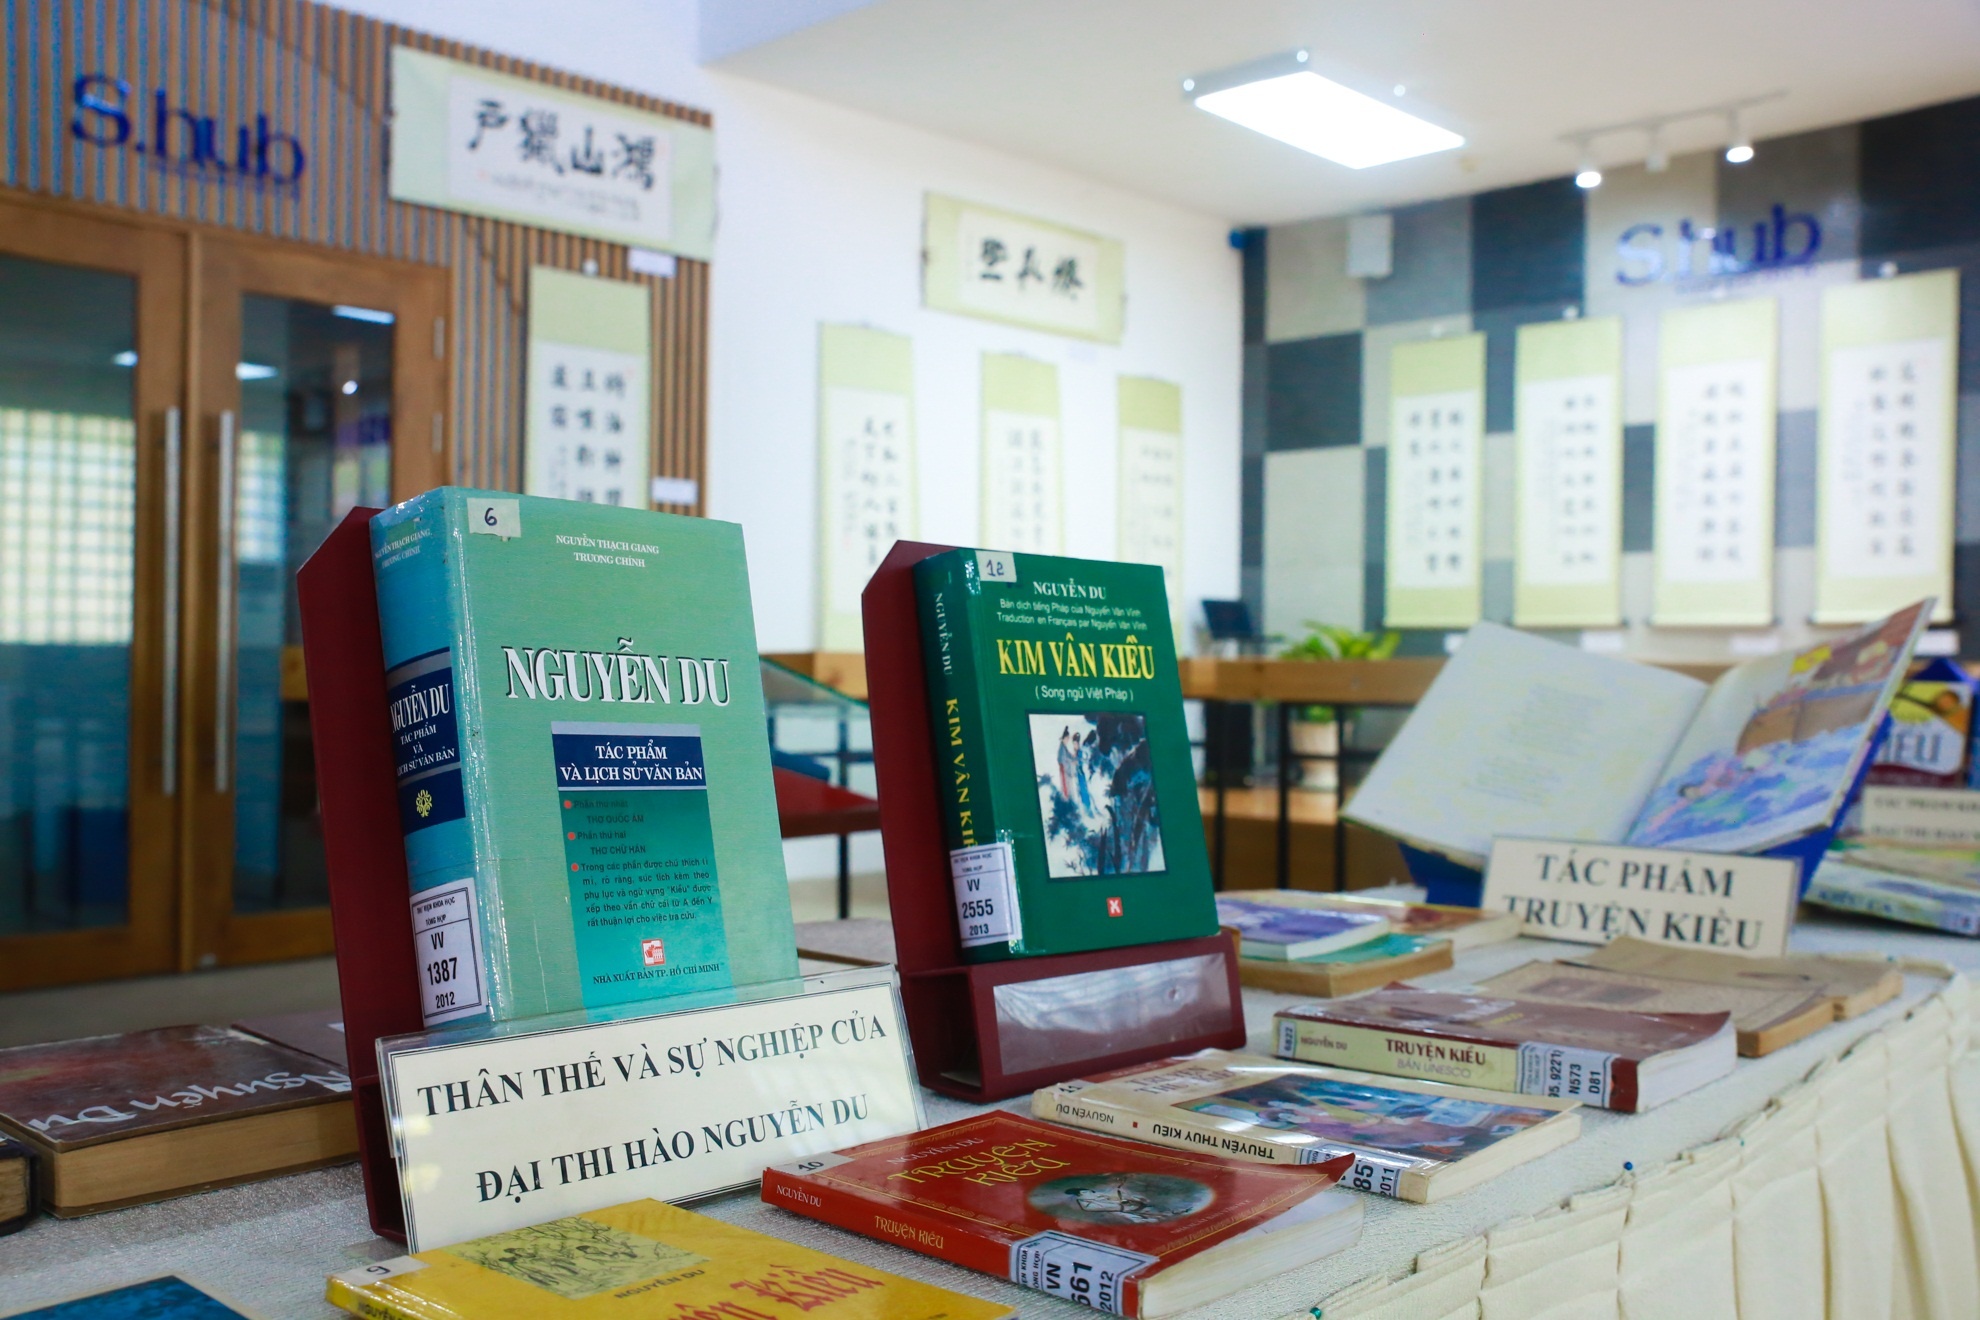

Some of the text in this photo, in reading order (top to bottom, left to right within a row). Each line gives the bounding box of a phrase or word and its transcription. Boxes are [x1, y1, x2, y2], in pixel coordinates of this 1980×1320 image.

[70, 73, 304, 185] S.hub
[484, 507, 498, 527] 6
[556, 533, 659, 554] NGUYỄN THẠCH GIANG
[615, 555, 646, 568] CHÍNH
[986, 559, 1005, 577] 12
[1033, 578, 1107, 600] NGUYỄN DU
[997, 612, 1034, 624] Traduction
[1037, 616, 1046, 624] en
[1048, 615, 1078, 628] Français
[1079, 618, 1090, 629] par
[934, 592, 953, 676] NGUYỄN DU
[997, 632, 1155, 680] KIM VÂN KIỀU
[501, 637, 731, 706] NGUYỄN DU
[1041, 685, 1066, 700] Song
[1086, 686, 1104, 700] Việt
[1105, 686, 1128, 702] Pháp
[390, 684, 450, 733] NGUYỄN DU
[400, 722, 437, 745] TÁC PHẨM
[413, 741, 424, 754] VÀ
[418, 746, 455, 767] VĂN BẢN
[595, 739, 668, 760] TÁC PHẨM
[946, 698, 971, 804] KIM VÂN
[560, 761, 702, 784] VÀ LỊCH SỬ VĂN BẢN
[614, 830, 626, 839] hai
[590, 846, 608, 855] THƠ
[581, 863, 604, 872] Trong
[606, 862, 620, 870] các
[644, 860, 662, 870] được
[682, 858, 700, 866] thích
[674, 872, 690, 880] kèm
[693, 871, 710, 880] theo
[1537, 849, 1736, 897] TÁC PHẨM
[584, 890, 600, 901] phụ
[602, 889, 614, 899] lục
[616, 888, 626, 897] và
[692, 883, 712, 894] được
[966, 878, 980, 892] VV
[586, 902, 600, 914] xếp
[604, 903, 620, 912] theo
[658, 898, 670, 908] cái
[682, 899, 689, 907] A
[692, 896, 705, 906] đến
[707, 896, 713, 905] Y
[962, 898, 994, 920] 2555
[588, 915, 598, 927] rất
[600, 915, 622, 926] thuận
[624, 914, 634, 924] lợi
[636, 914, 650, 924] cho
[652, 912, 668, 924] việc
[669, 912, 680, 920] tra
[969, 923, 990, 936] 2013
[1503, 894, 1764, 950] TRUYỆN KIỀU
[430, 931, 444, 950] VV
[427, 957, 458, 986] 1387
[593, 964, 720, 984] NHÀ XUẤT BẢN TP. HỒ CHÍ MINH
[435, 991, 456, 1009] 2012
[1336, 1042, 1348, 1050] DU
[1386, 1039, 1486, 1066] TRUYỆN KIỀU
[418, 1010, 887, 1116] THÂN THẾ VÀ SỰ NGHIỆP CỦA
[1424, 1062, 1472, 1078] UNESCO
[1568, 1063, 1582, 1095] N573
[1588, 1070, 1601, 1094] D81
[28, 1105, 138, 1132] Du
[1056, 1103, 1070, 1114] DU
[476, 1094, 869, 1204] ĐẠI THI HÀO NGUYỄN DU
[959, 1137, 984, 1148] DU
[1221, 1138, 1275, 1160] TRUYỆN
[798, 1161, 825, 1172] 10
[1353, 1162, 1374, 1191] 85
[1380, 1168, 1395, 1198] 2011
[776, 1184, 822, 1208] NGUYỄN DU
[874, 1215, 944, 1250] TRUYỆN KIỀU
[366, 1265, 390, 1276] 9
[1046, 1262, 1061, 1290] VN
[614, 1269, 706, 1299] NGUYỄN DU
[1070, 1261, 1093, 1307] 661
[1099, 1270, 1115, 1312] 2012
